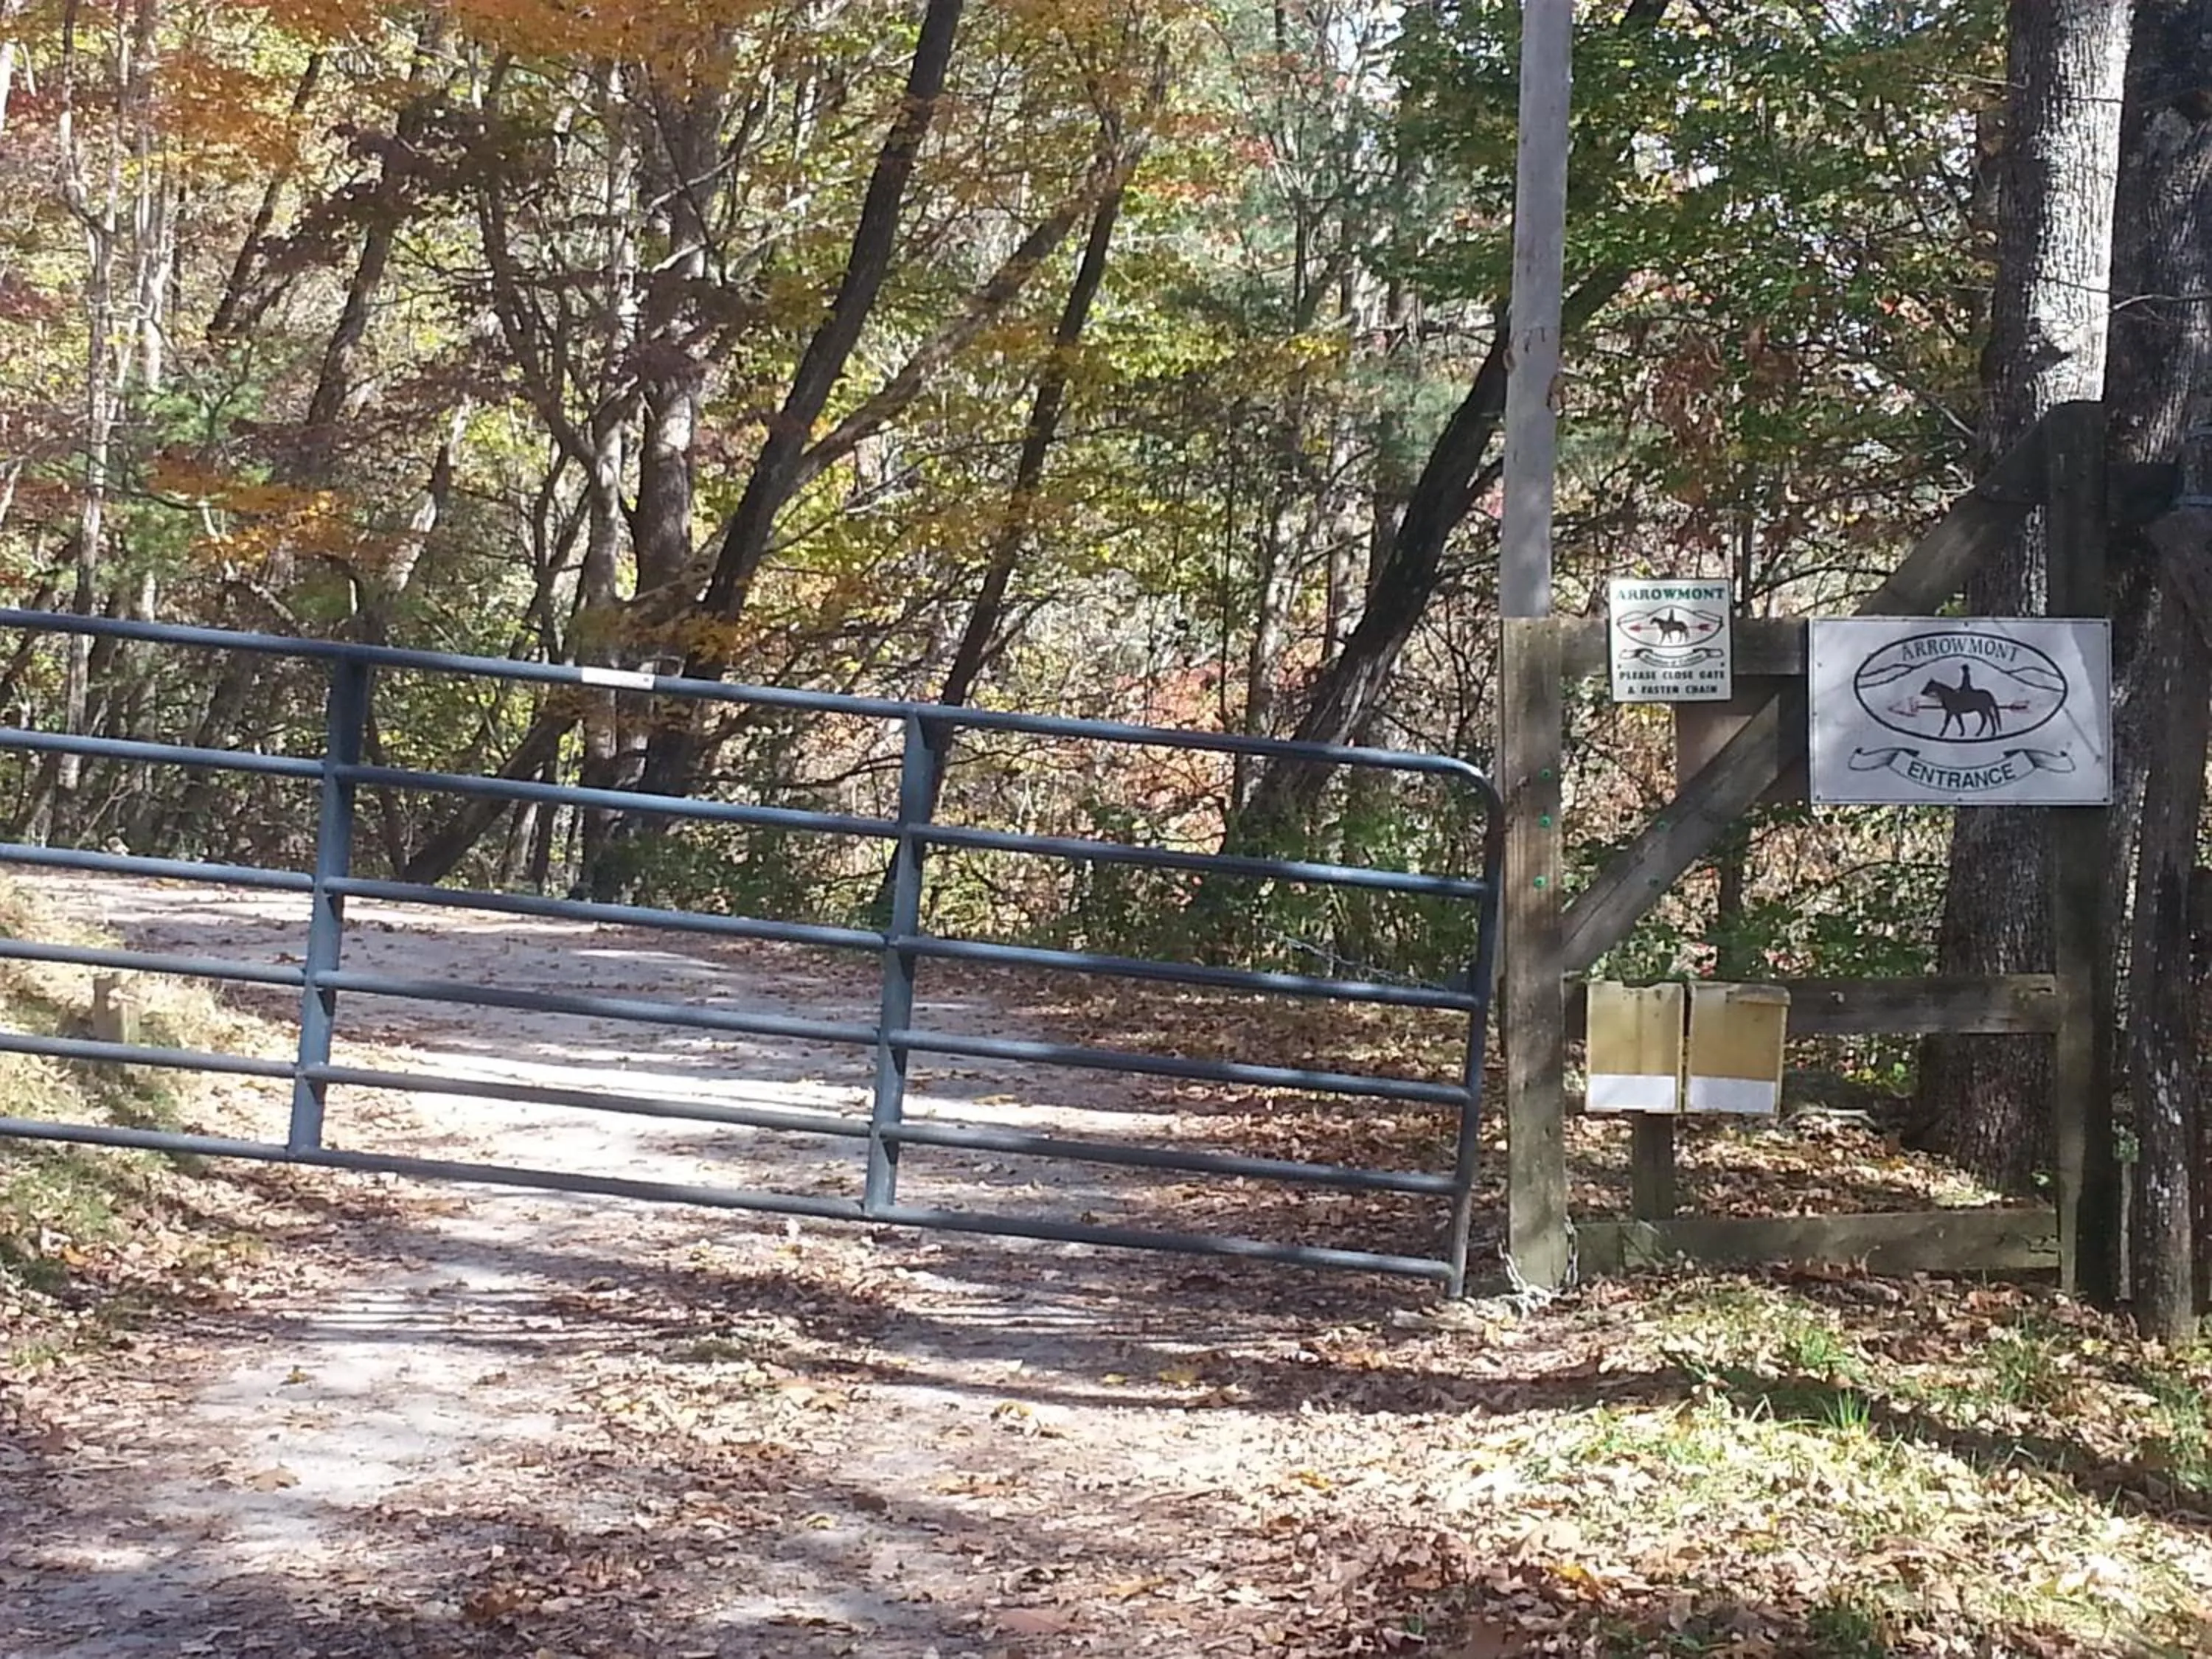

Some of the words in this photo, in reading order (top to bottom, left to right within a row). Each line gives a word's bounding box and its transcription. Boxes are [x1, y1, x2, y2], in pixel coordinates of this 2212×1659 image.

[1617, 587, 1725, 600] ARROWMONT
[1902, 637, 2019, 662] ARROWMONT
[1619, 670, 1656, 680] PLEASE
[1663, 670, 1693, 680] CLOSE
[1699, 670, 1725, 679] GATE
[1641, 684, 1680, 694] FASTEN
[1686, 684, 1717, 694] CHAIN
[1907, 762, 2016, 789] ENTRANCE
